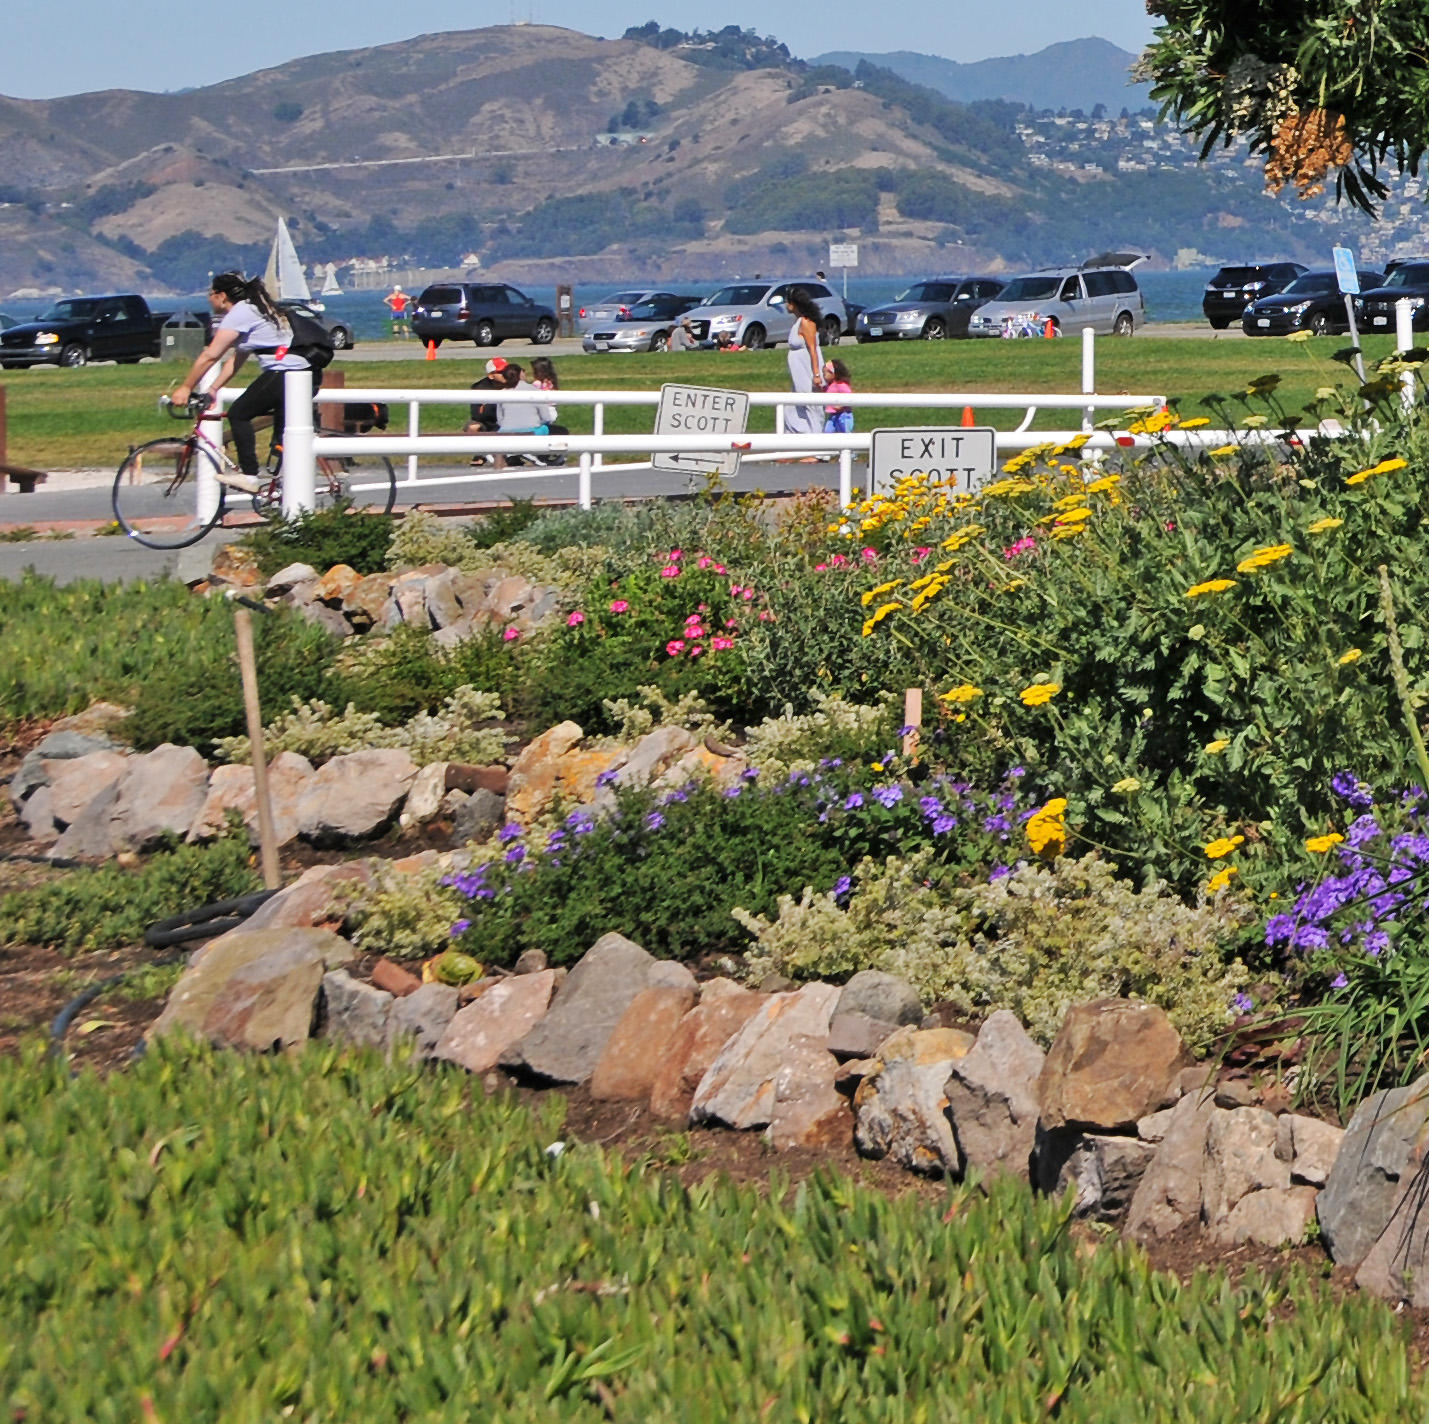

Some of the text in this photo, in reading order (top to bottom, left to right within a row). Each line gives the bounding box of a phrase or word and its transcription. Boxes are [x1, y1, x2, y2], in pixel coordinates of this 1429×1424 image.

[672, 392, 736, 412] ENTER
[670, 413, 732, 433] SCOTT
[901, 437, 964, 459] EXIT
